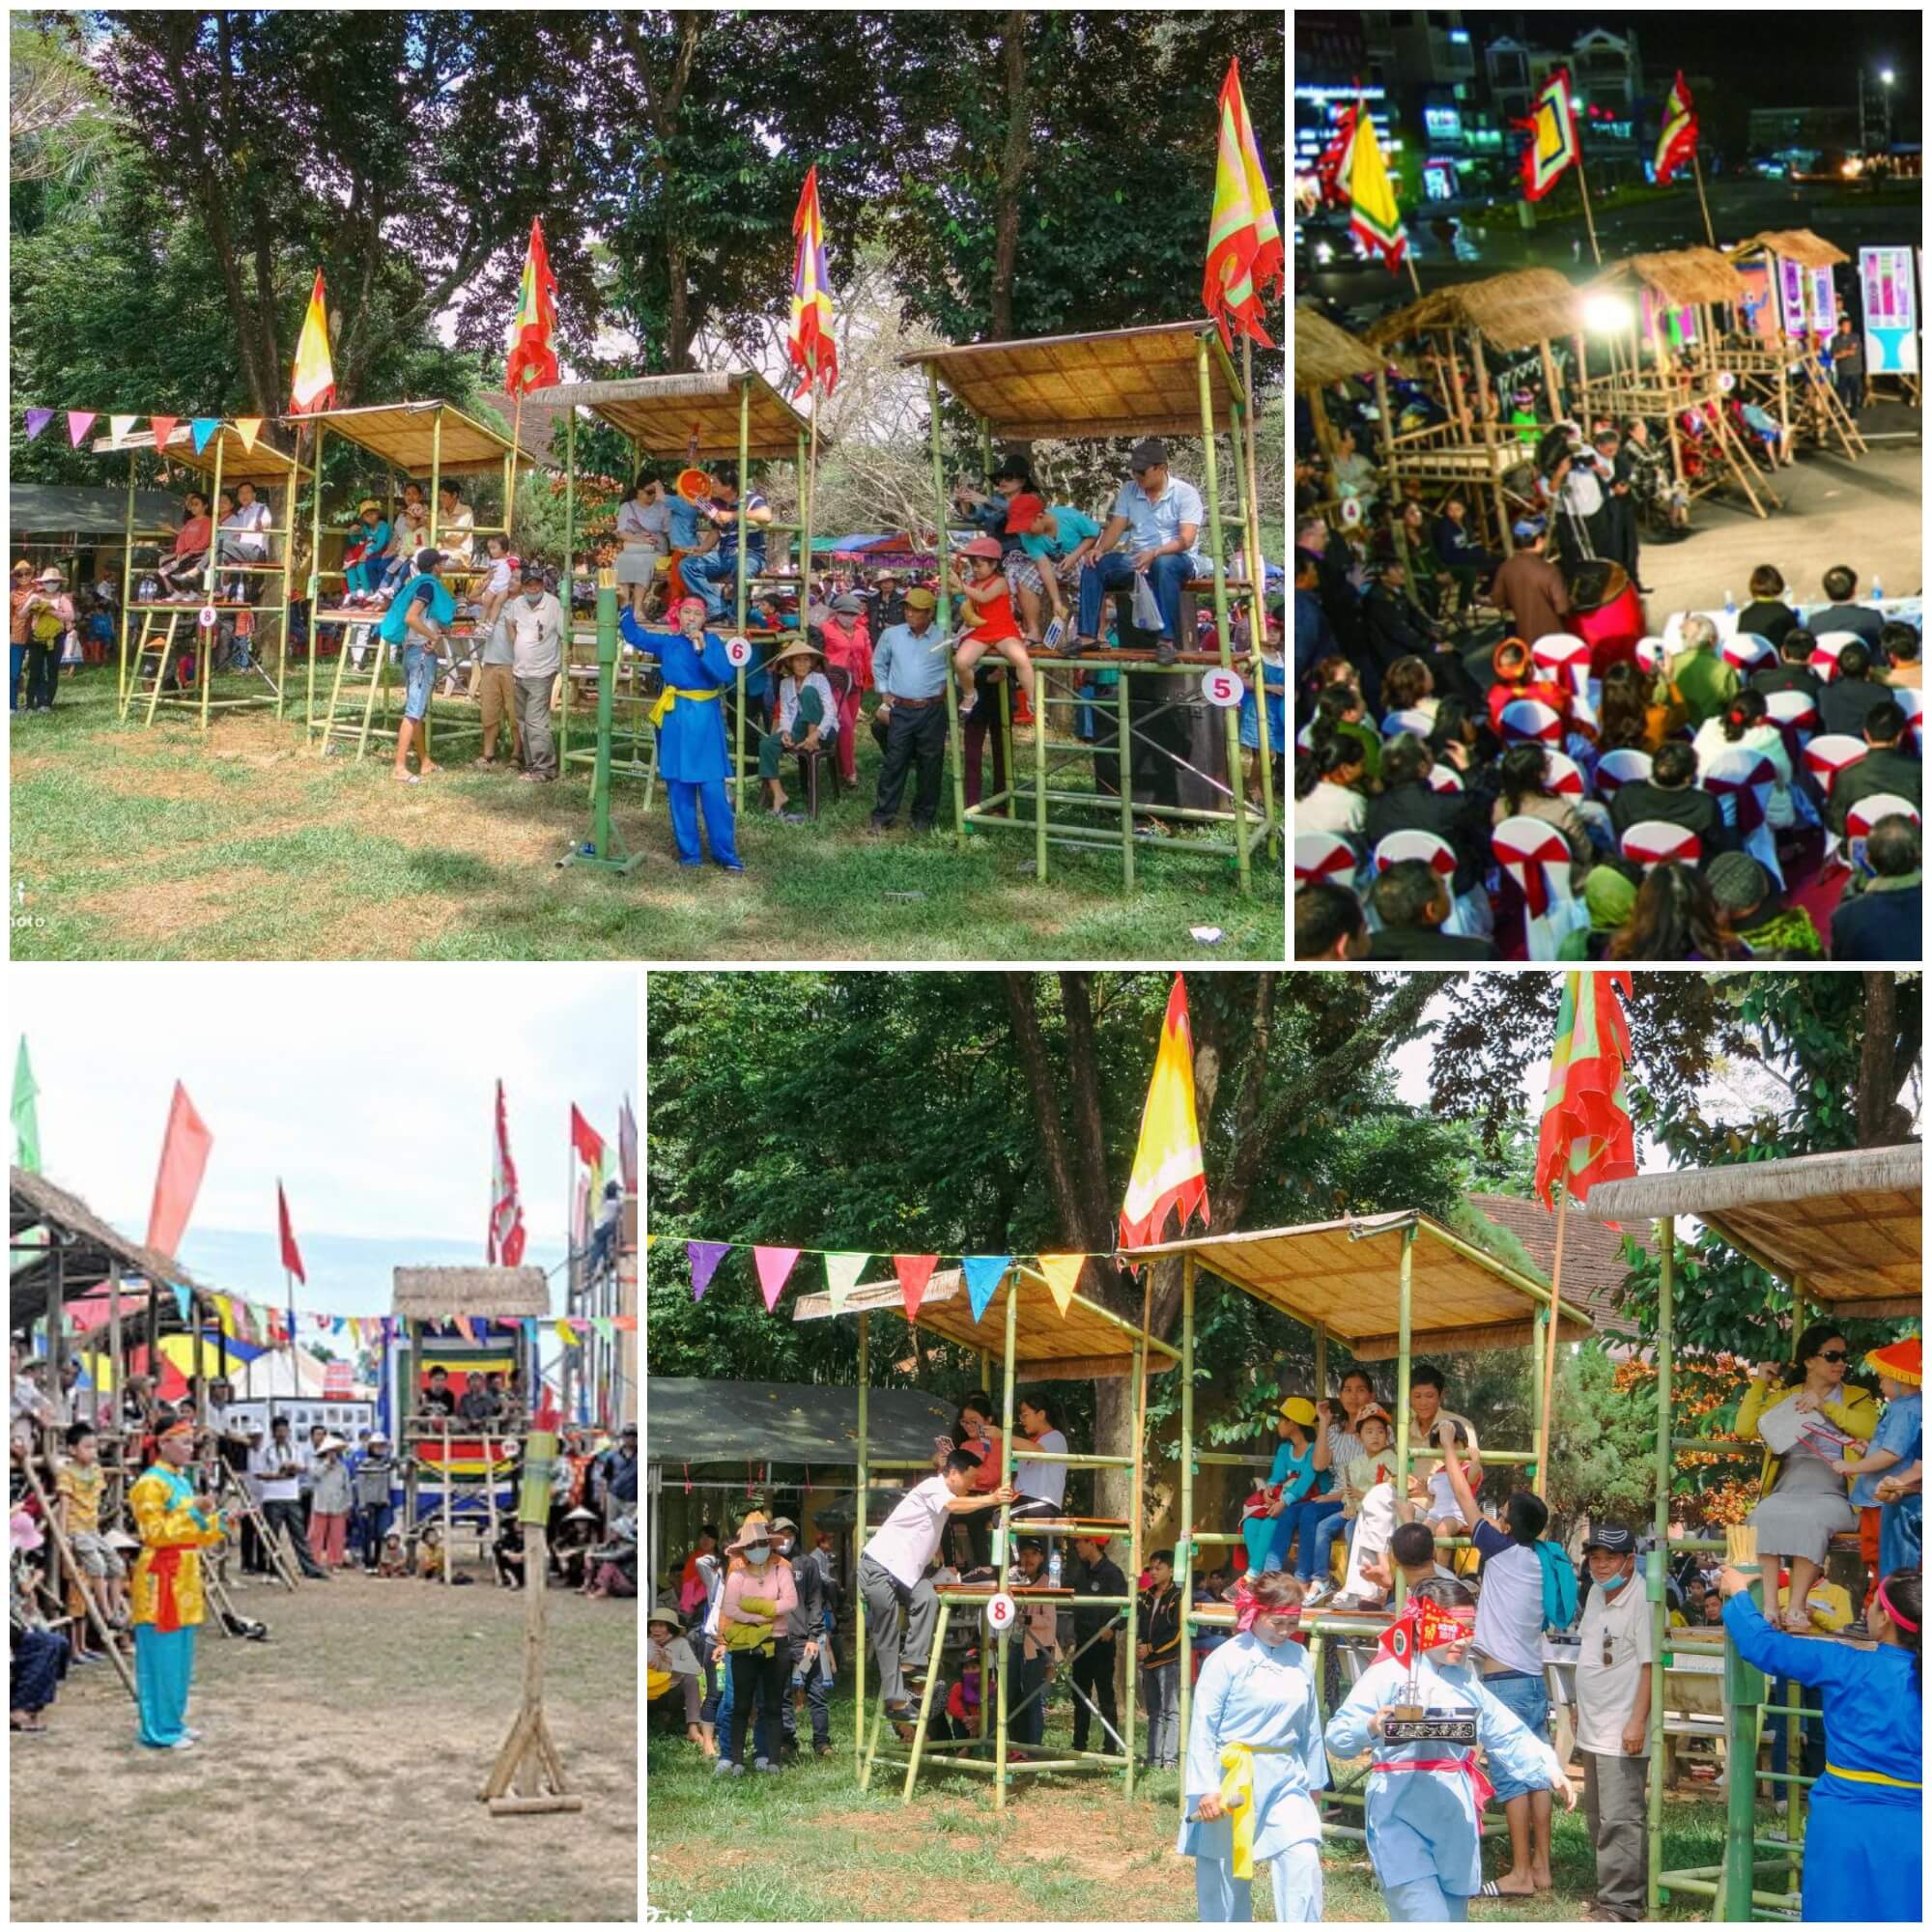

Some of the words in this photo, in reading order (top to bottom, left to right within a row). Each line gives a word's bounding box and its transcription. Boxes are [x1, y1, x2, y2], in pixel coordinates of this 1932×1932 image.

[732, 643, 743, 659] 6
[1213, 678, 1231, 698] 5
[995, 1602, 1006, 1620] 8
